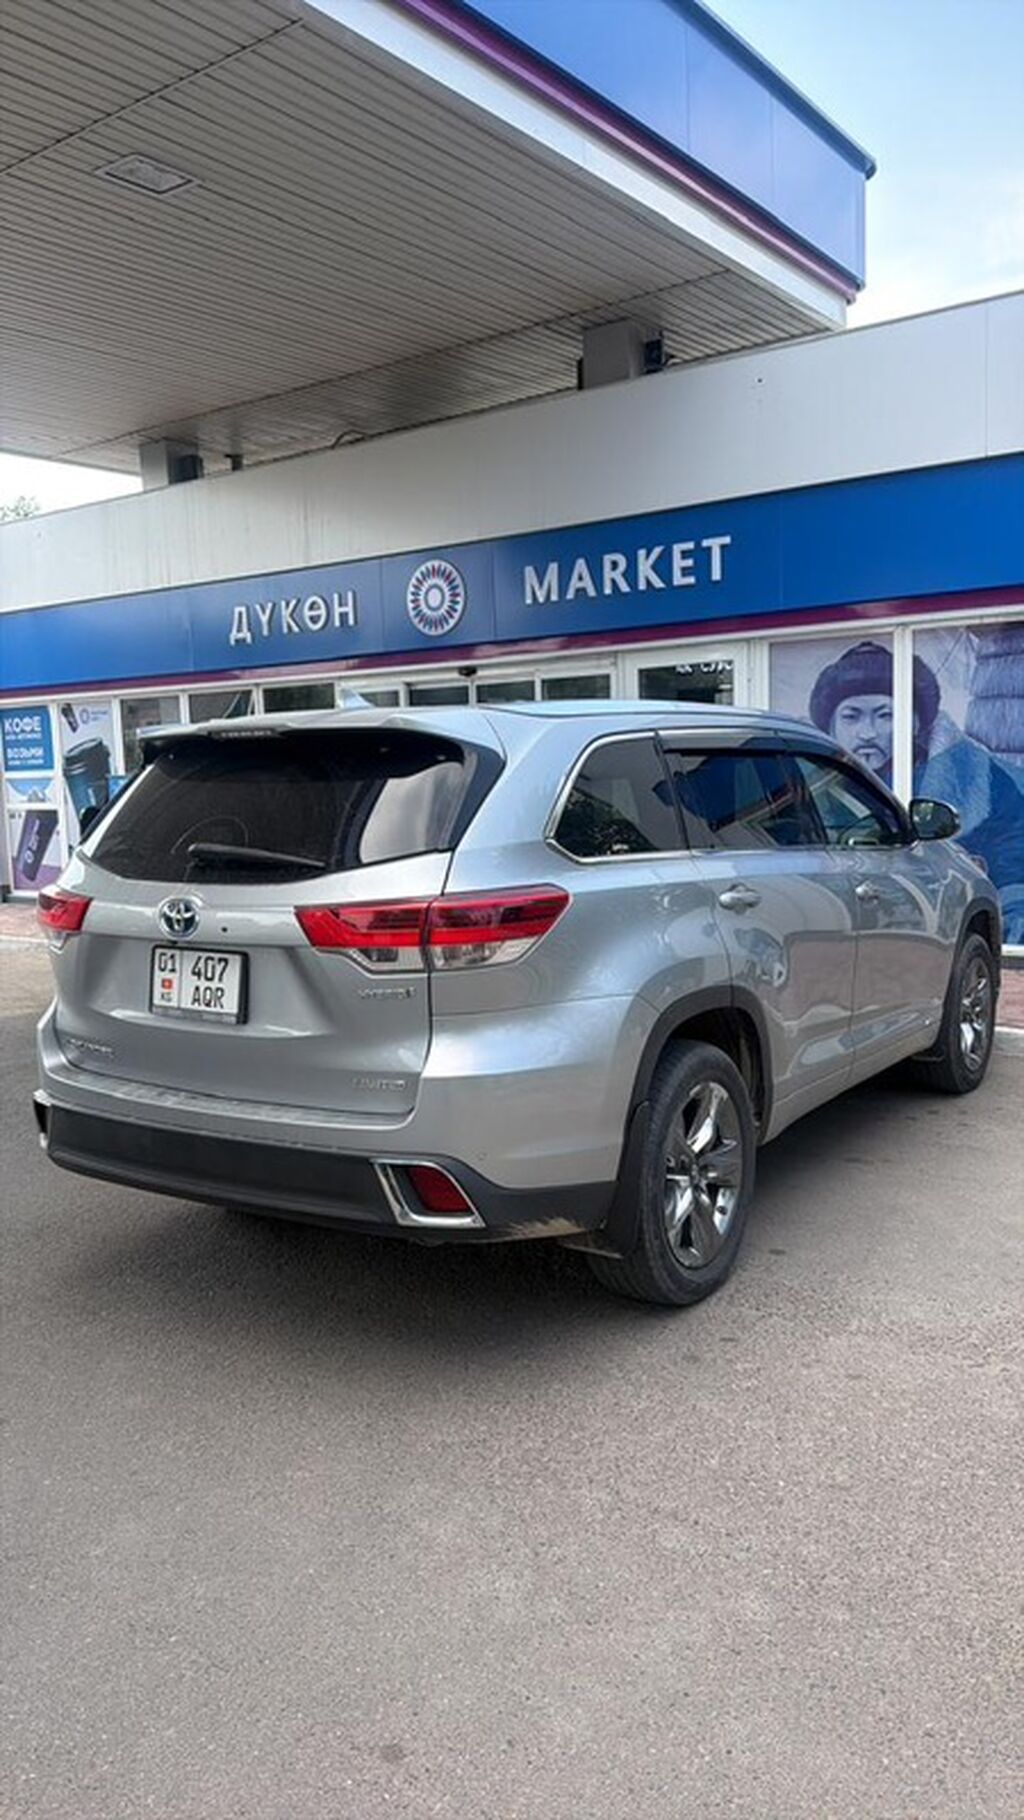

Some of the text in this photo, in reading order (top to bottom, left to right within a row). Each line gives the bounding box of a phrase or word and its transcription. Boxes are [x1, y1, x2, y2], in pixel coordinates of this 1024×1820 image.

[524, 535, 731, 605] MARKET
[229, 590, 356, 647] ДҮКӨН
[4, 715, 42, 733] КОФЕ
[158, 952, 177, 973] 01
[190, 955, 229, 983] 407
[191, 985, 225, 1010] AQR
